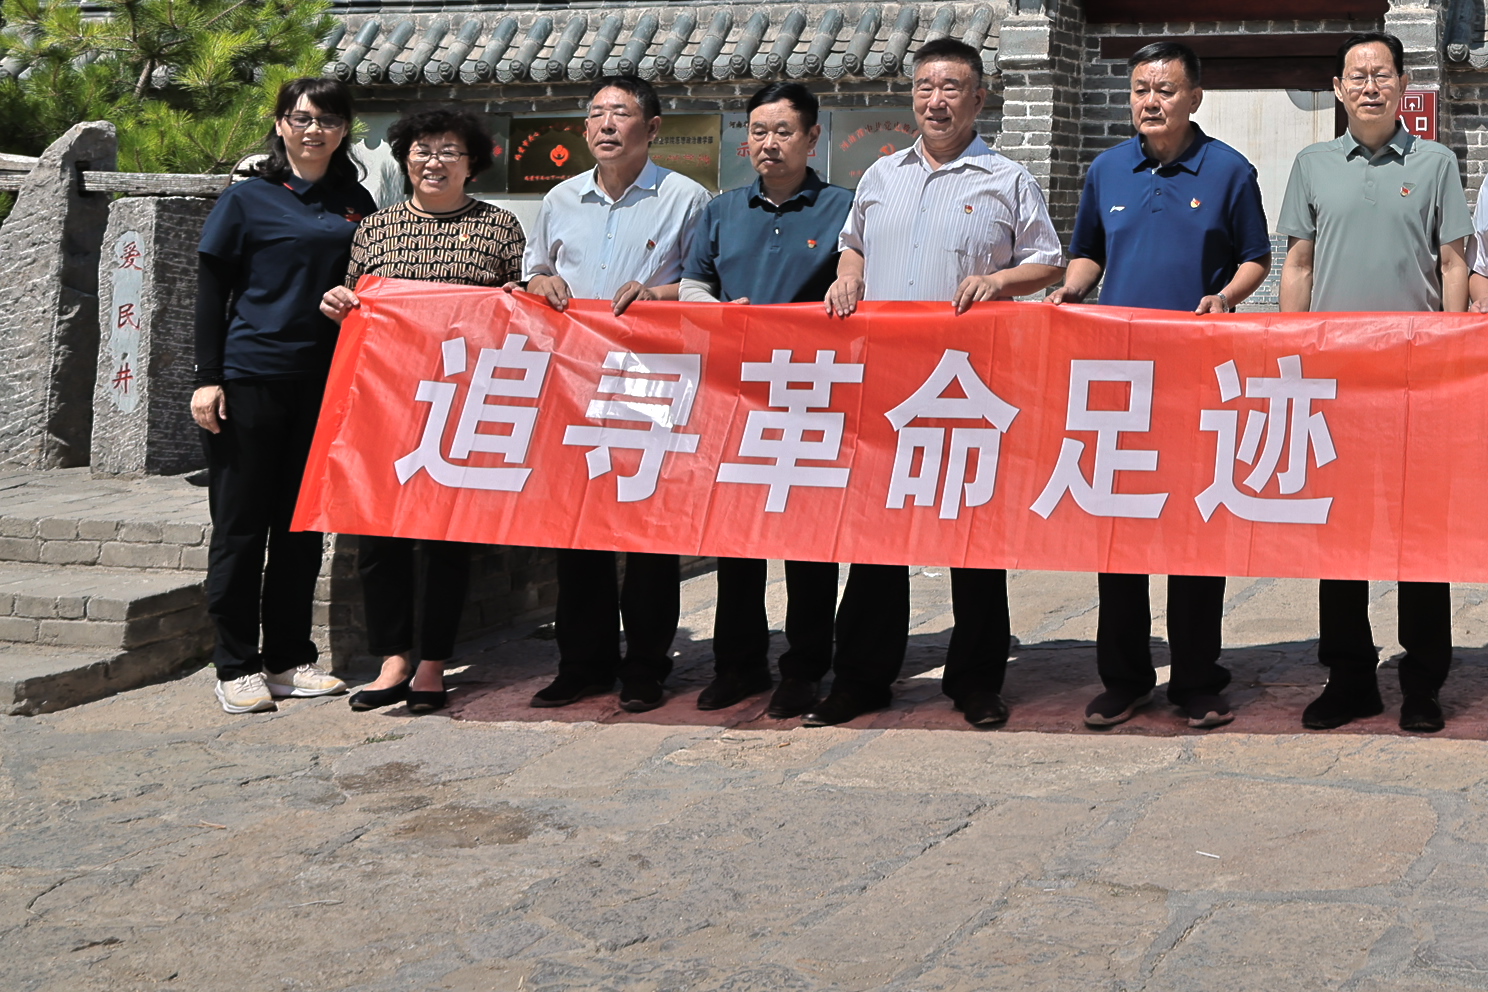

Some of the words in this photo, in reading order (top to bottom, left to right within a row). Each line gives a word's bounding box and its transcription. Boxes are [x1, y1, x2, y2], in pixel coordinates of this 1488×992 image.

[112, 242, 143, 394] 爱民井
[394, 335, 1339, 524] 追寻革命足迹
